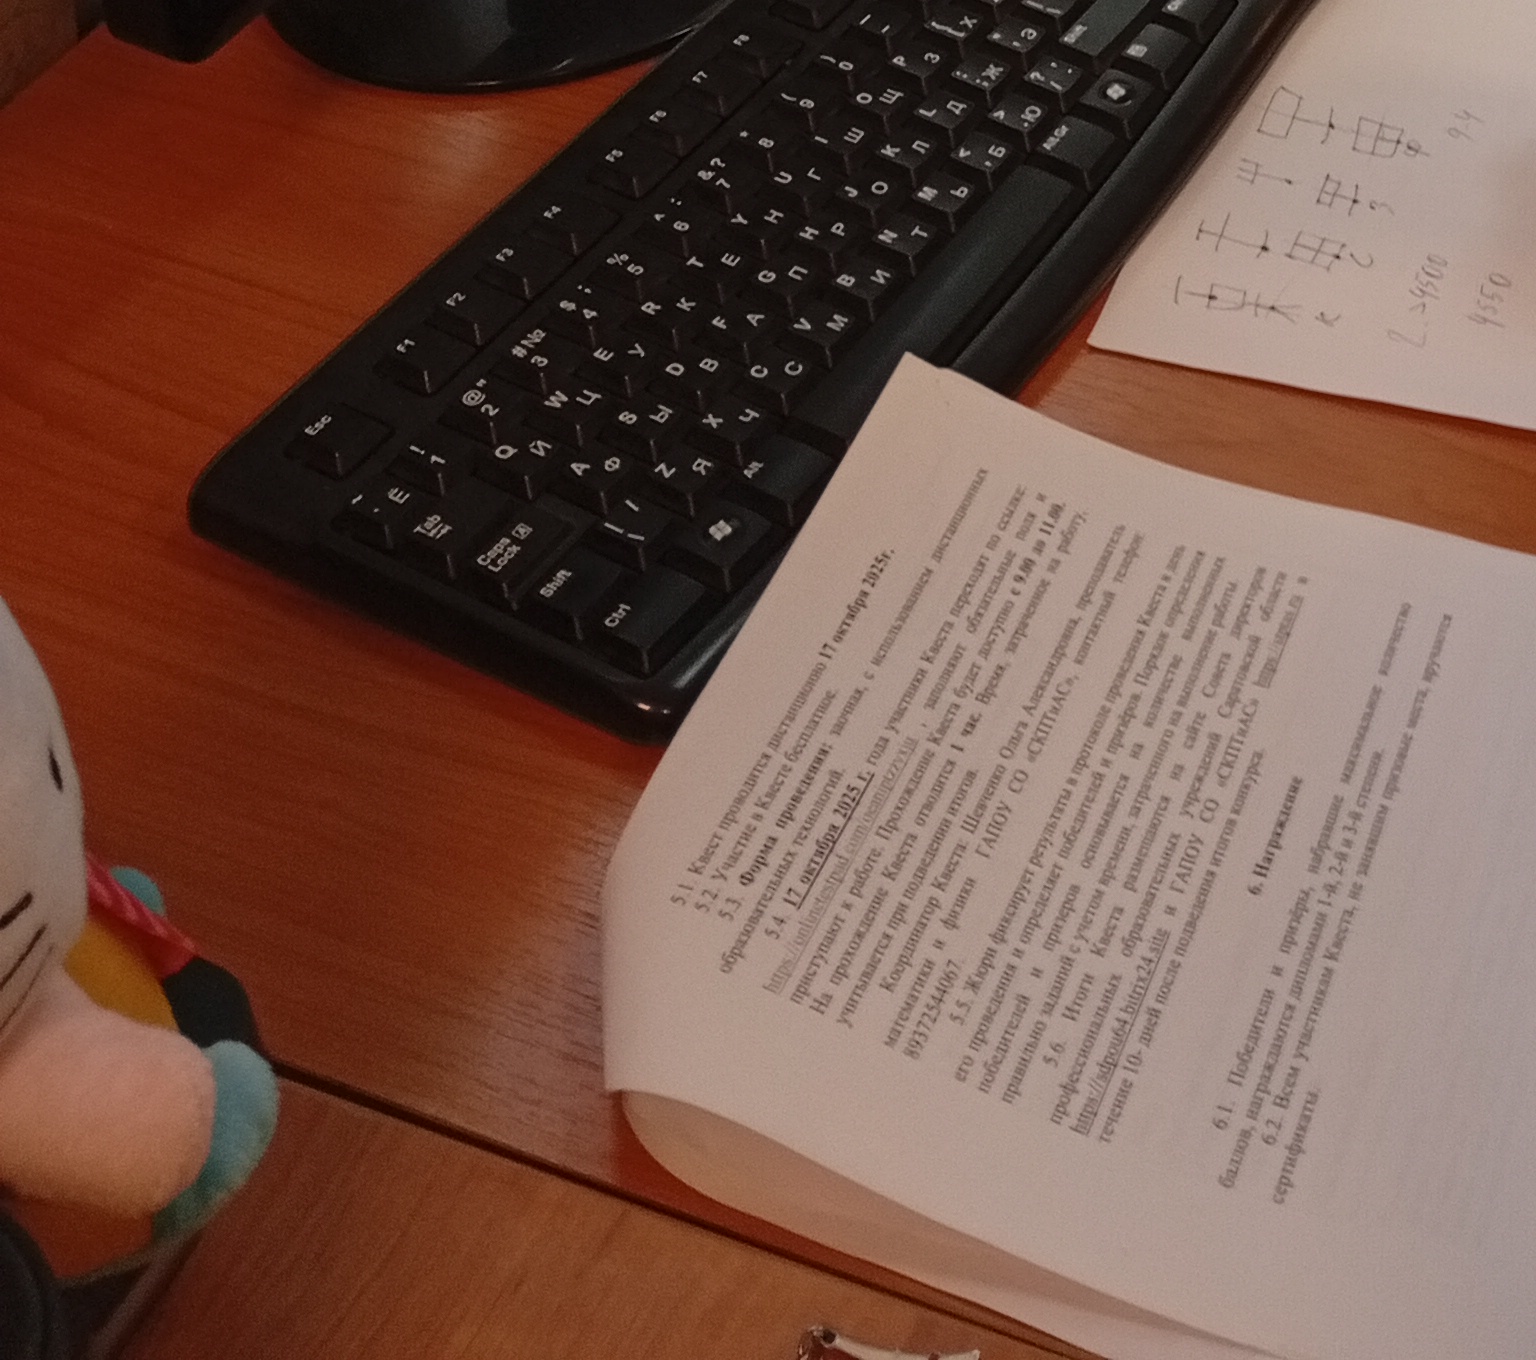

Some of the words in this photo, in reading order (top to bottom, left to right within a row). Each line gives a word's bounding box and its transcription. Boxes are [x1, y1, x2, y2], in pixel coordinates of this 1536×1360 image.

[691, 69, 708, 83] F7
[878, 87, 904, 104] Щ
[542, 204, 561, 219] F4
[494, 247, 514, 262] F3
[626, 262, 644, 275] 5
[787, 264, 808, 280] П
[869, 268, 890, 284] И
[444, 291, 466, 307] F2
[581, 307, 598, 319] 4
[395, 337, 415, 353] F1
[529, 354, 548, 367] 3
[664, 362, 685, 376] D
[543, 389, 568, 408] W
[574, 388, 602, 406] Ц
[479, 402, 500, 417] 2
[617, 410, 637, 424] S
[648, 404, 673, 423] Ы
[303, 414, 332, 436] Esc
[493, 444, 518, 459] Q
[528, 439, 552, 457] Й
[603, 455, 621, 472] Ф
[653, 461, 676, 478] Z
[691, 457, 712, 475] Я
[742, 460, 764, 479] Alt
[412, 513, 441, 536] Tab
[475, 536, 511, 569] Caps
[486, 544, 521, 572] Lock
[538, 568, 572, 597] Shift
[603, 602, 631, 627] Ctrl
[685, 831, 724, 876] Квест
[716, 750, 773, 831] проводится
[815, 641, 838, 660] 17
[829, 588, 870, 644] октября
[859, 548, 896, 588] 2025г.
[779, 886, 803, 907] 17
[795, 821, 840, 885] октября
[829, 782, 861, 818] 2025
[862, 733, 889, 766] года
[881, 665, 927, 733] участники
[915, 618, 953, 664] Квеста
[788, 913, 846, 1005] приступают
[872, 747, 935, 841] Прохождение
[923, 700, 960, 746] Квеста
[948, 661, 981, 699] будет
[1010, 555, 1037, 585] 9.00
[710, 822, 758, 883] Участие
[752, 763, 793, 811] Квесте
[735, 833, 780, 889] Форма
[773, 741, 833, 830] проведения:
[1250, 774, 1304, 879] Награждение
[876, 893, 944, 994] Координатор
[957, 762, 1007, 834] Шевченко
[994, 718, 1029, 761] Ольга
[1165, 831, 1204, 894] ГАПОУ
[1194, 794, 1219, 824] СО
[807, 990, 834, 1016] На
[827, 885, 889, 986] прохождение
[878, 830, 918, 882] Квеста
[911, 757, 957, 827] отводится
[1243, 880, 1264, 897] 6.
[716, 848, 798, 976] образовательных
[881, 956, 936, 1049] математики
[936, 874, 977, 932] физики
[971, 800, 1013, 859] ГАПОУ
[1003, 766, 1030, 795] СО
[834, 930, 894, 1028] учитывается
[884, 899, 909, 931] при
[900, 815, 953, 901] подведении
[952, 1052, 976, 1084] его
[966, 960, 1018, 1053] проведения
[1015, 861, 1064, 945] определяет
[1054, 768, 1106, 860] победителей
[960, 944, 997, 995] Жюри
[983, 865, 1035, 947] фиксирует
[1059, 970, 1095, 1023] Итоги
[1086, 903, 1124, 958] Квеста
[1242, 1000, 1296, 1121] награждаются
[1326, 847, 1349, 876] 2-й
[1340, 808, 1363, 836] 3-й
[975, 990, 1031, 1095] победителей
[1039, 881, 1081, 952] призеров
[1047, 971, 1123, 1126] профессиональных
[1117, 830, 1181, 958] образовательных
[1096, 1076, 1134, 1145] течение
[1136, 1003, 1163, 1049] дней
[1152, 957, 1182, 1006] после
[1172, 867, 1218, 958] подведения
[1208, 816, 1239, 869] итогов
[998, 1017, 1047, 1105] правильно
[1037, 951, 1076, 1017] заданий
[1071, 886, 1105, 943] учетом
[1224, 985, 1275, 1088] Победители
[1269, 1062, 1300, 1111] Всем
[1290, 963, 1334, 1062] участникам
